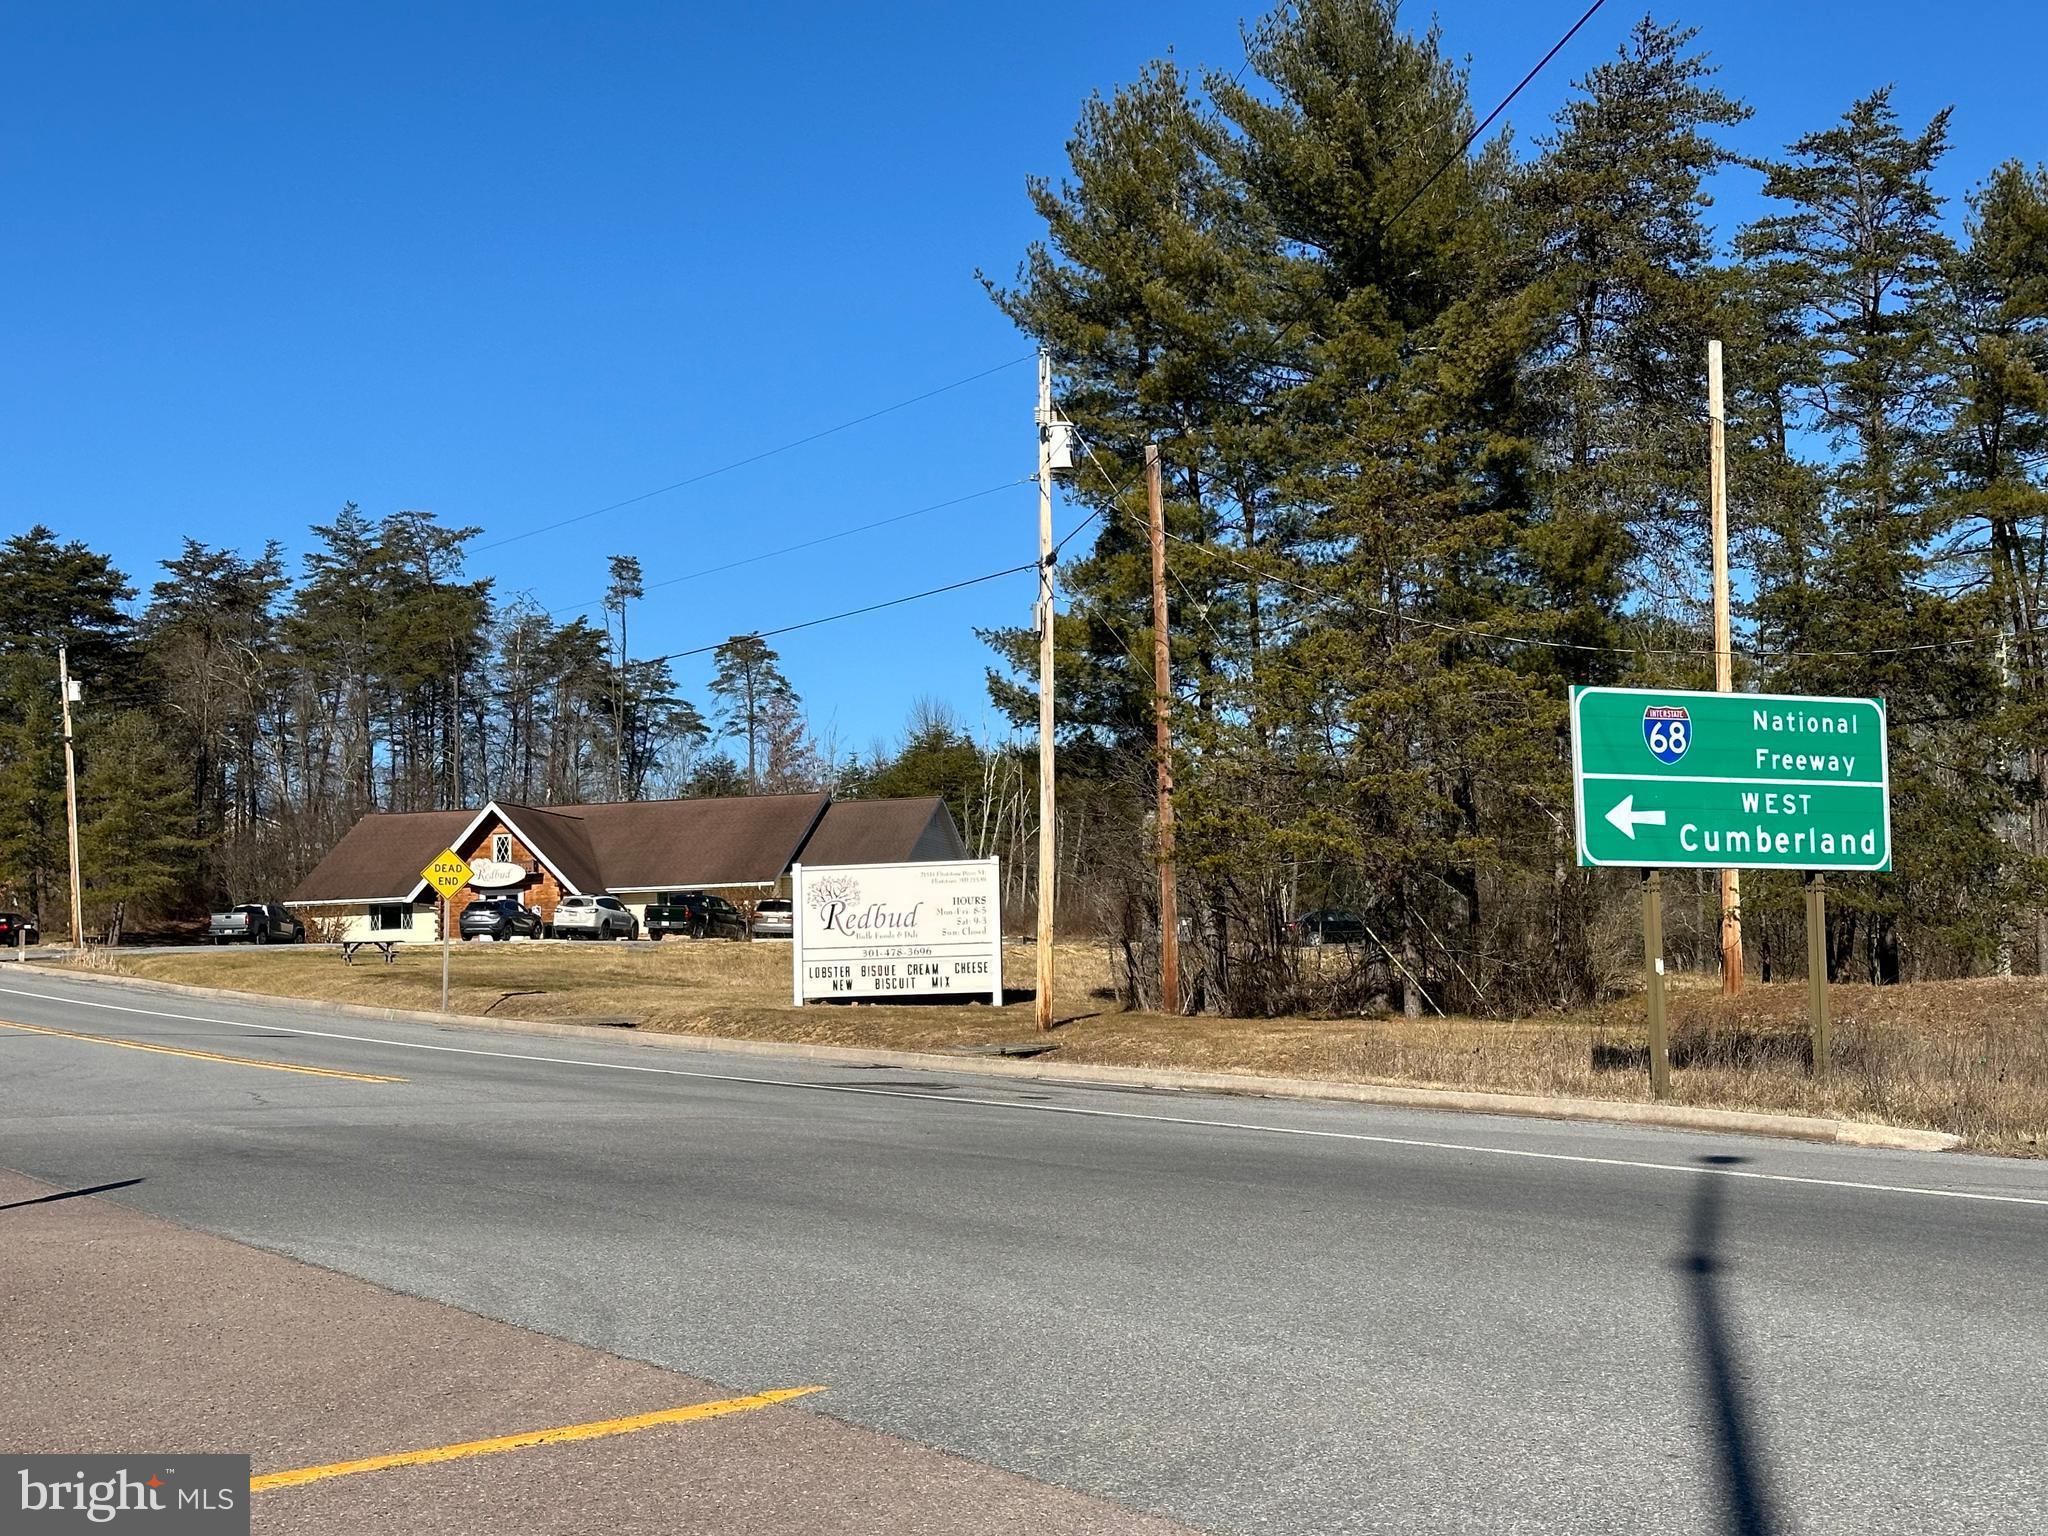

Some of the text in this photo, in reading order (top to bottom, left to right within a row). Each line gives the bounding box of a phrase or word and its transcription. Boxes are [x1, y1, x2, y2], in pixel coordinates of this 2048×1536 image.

[1649, 710, 1684, 718] INTERSTATE
[1753, 710, 1858, 734] National
[1650, 721, 1687, 753] 68
[1756, 748, 1856, 777] Freeway
[1741, 792, 1812, 815] WEST
[1680, 823, 1876, 855] Cumberland
[434, 864, 463, 873] DEAD
[477, 867, 511, 882] Redbud
[438, 876, 459, 886] END
[952, 895, 987, 906] HOURS
[820, 899, 925, 937] Redbud
[862, 947, 932, 958] 301-478-3696
[809, 961, 988, 979] LOBSTER BISQUE CREAM CHEESE
[832, 976, 950, 991] NEW BISCUIT MIX
